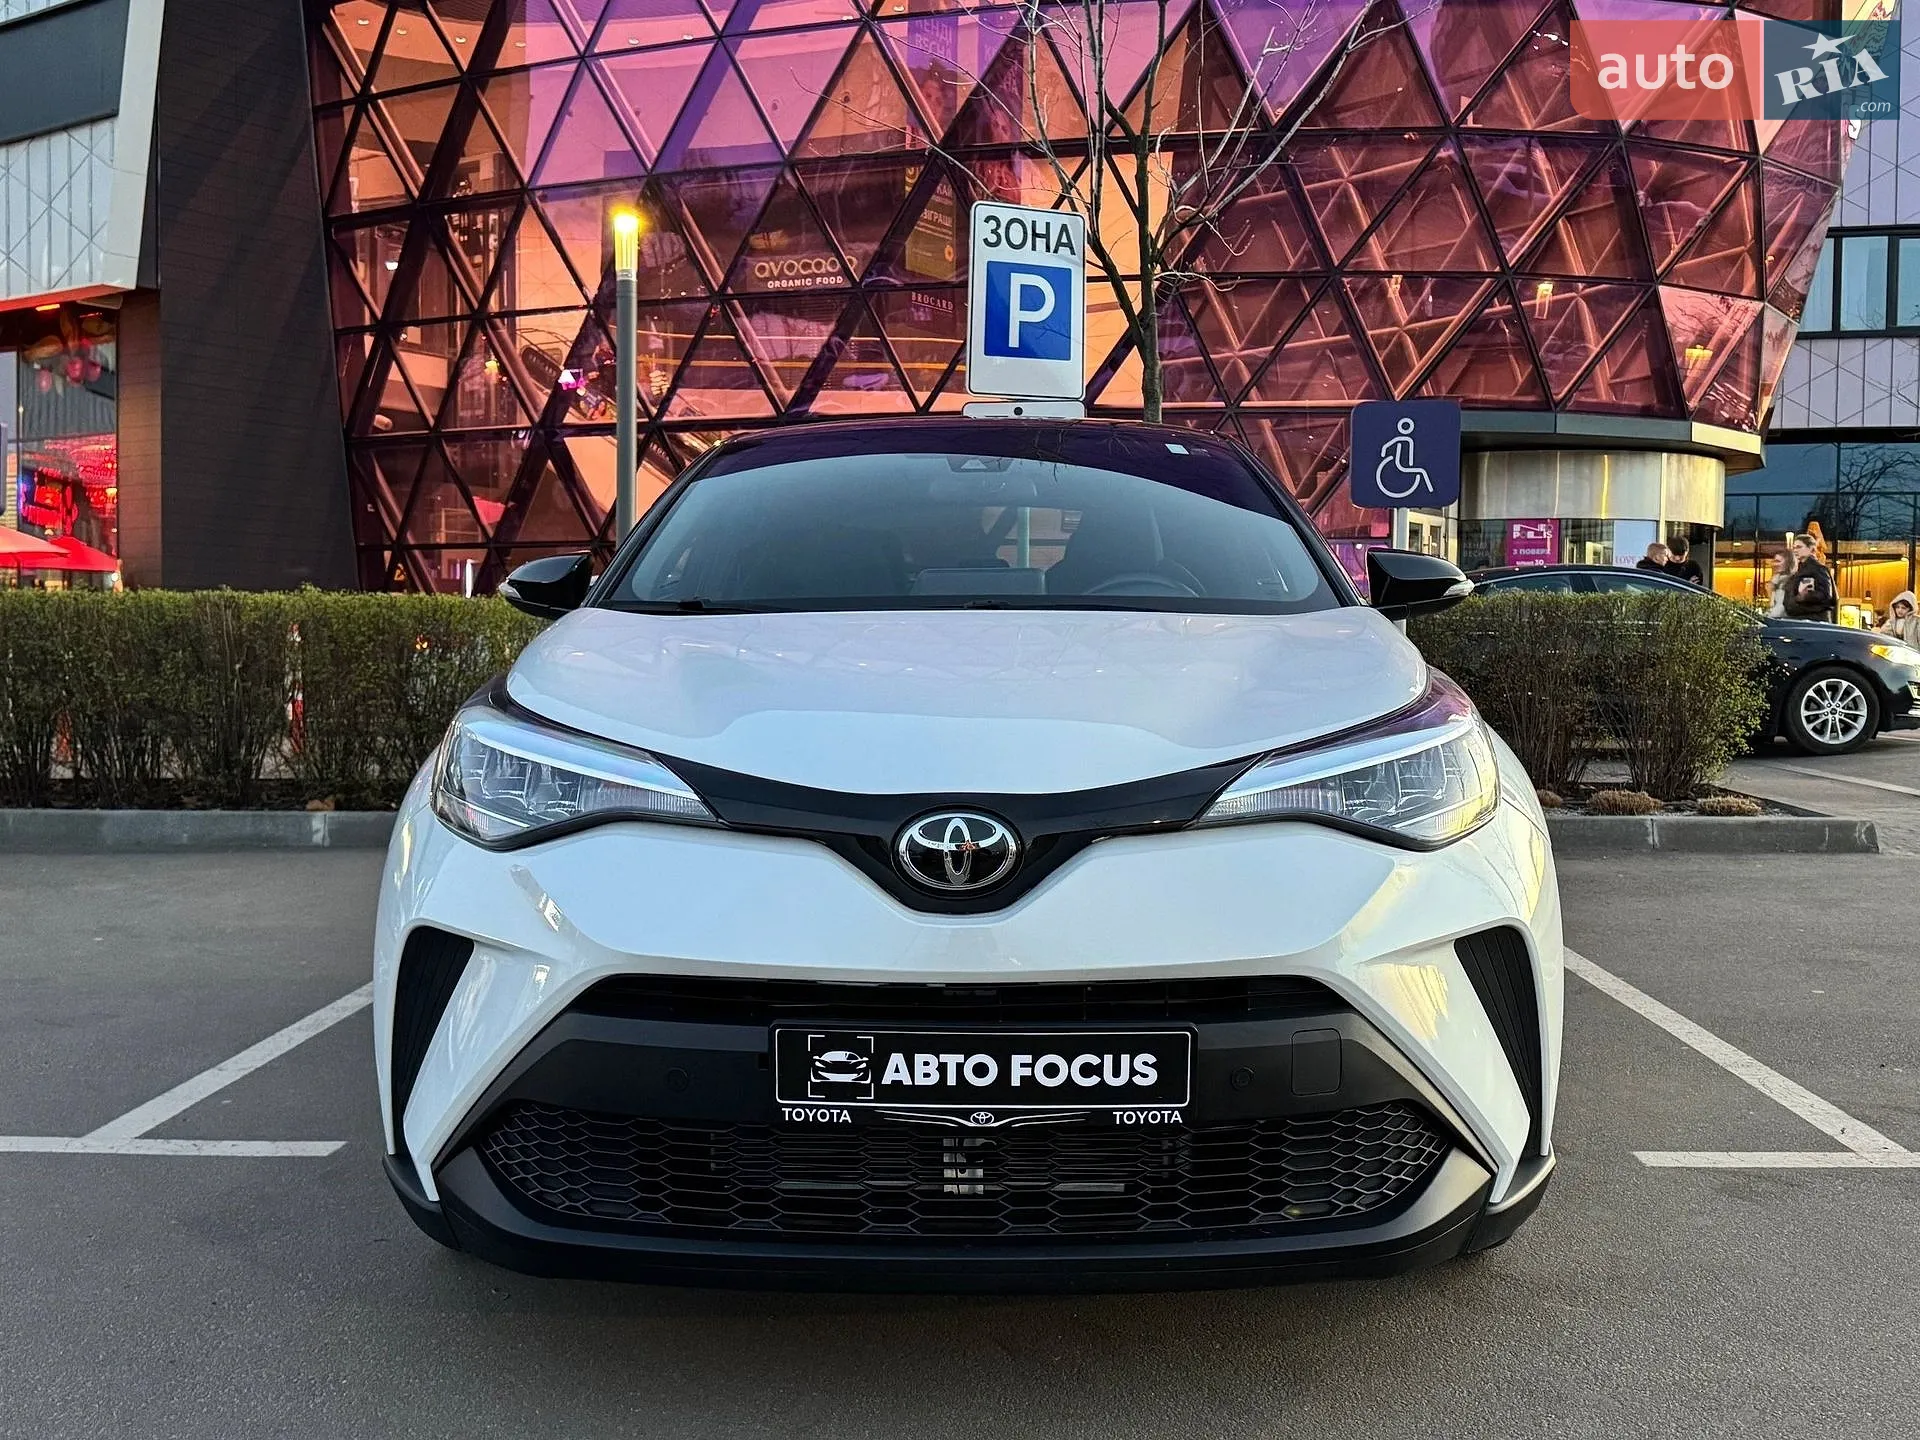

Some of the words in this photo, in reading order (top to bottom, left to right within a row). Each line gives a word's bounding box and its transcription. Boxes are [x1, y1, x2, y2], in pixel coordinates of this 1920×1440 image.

[982, 215, 1076, 256] ЗОНА
[767, 277, 812, 289] ORGANIC
[816, 276, 844, 285] FOOD
[911, 291, 954, 311] BROCARD
[1008, 272, 1056, 348] P
[881, 1053, 999, 1087] АВТО
[1010, 1053, 1158, 1087] FOCUS
[781, 1107, 852, 1124] TOYOTA
[1112, 1110, 1183, 1125] TOYOTA
